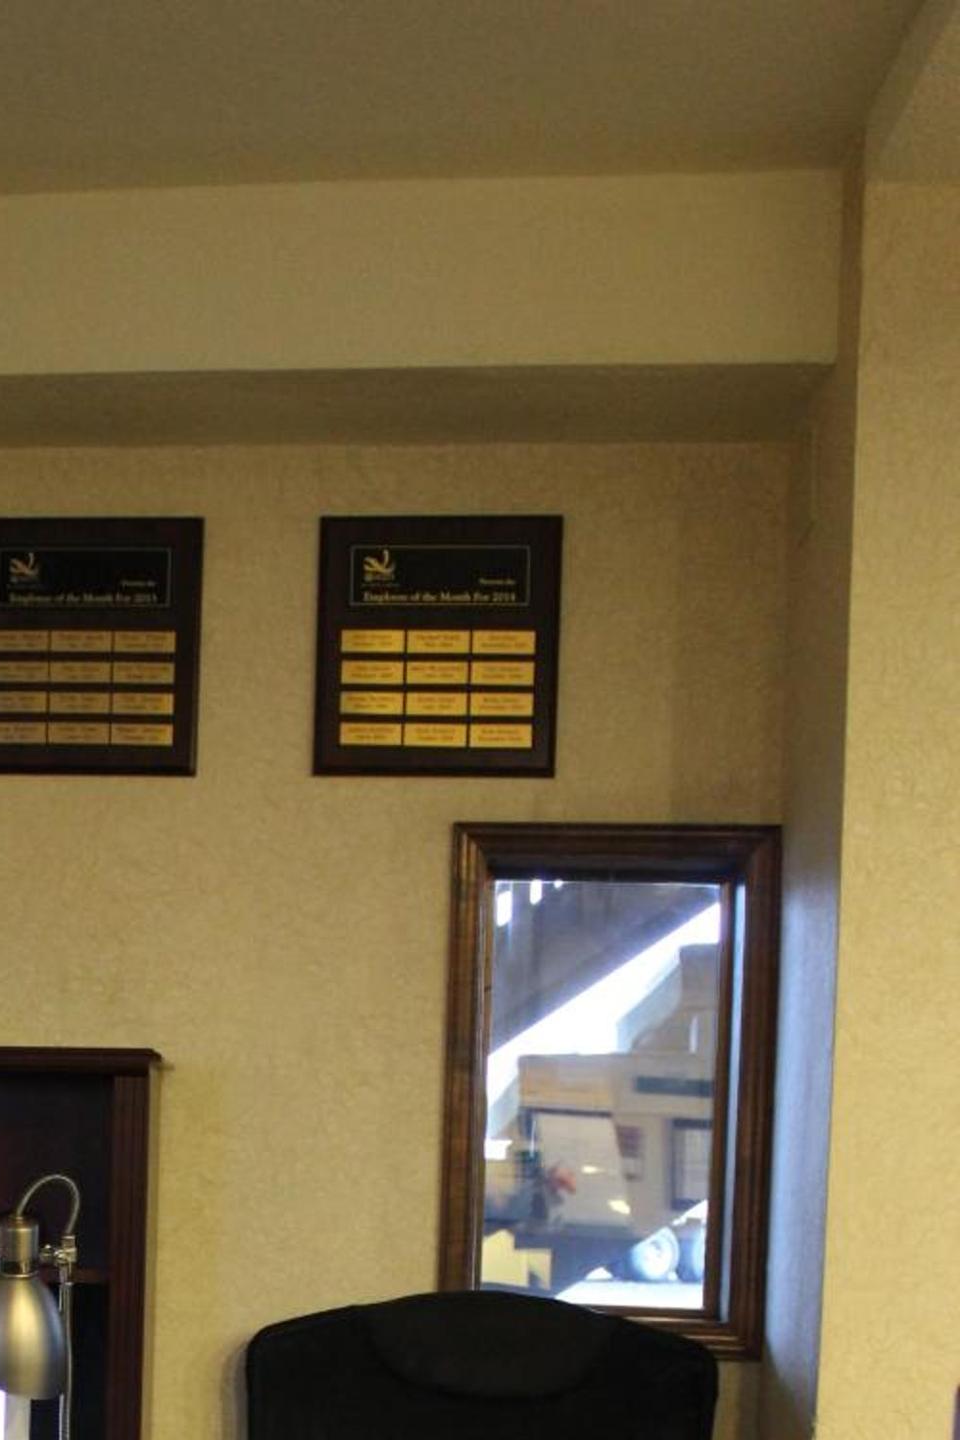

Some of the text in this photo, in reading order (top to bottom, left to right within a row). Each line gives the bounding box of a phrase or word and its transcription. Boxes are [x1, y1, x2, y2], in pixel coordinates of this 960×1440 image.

[82, 592, 114, 602] Month
[409, 591, 420, 602] of
[422, 591, 437, 602] the
[440, 591, 471, 602] Month
